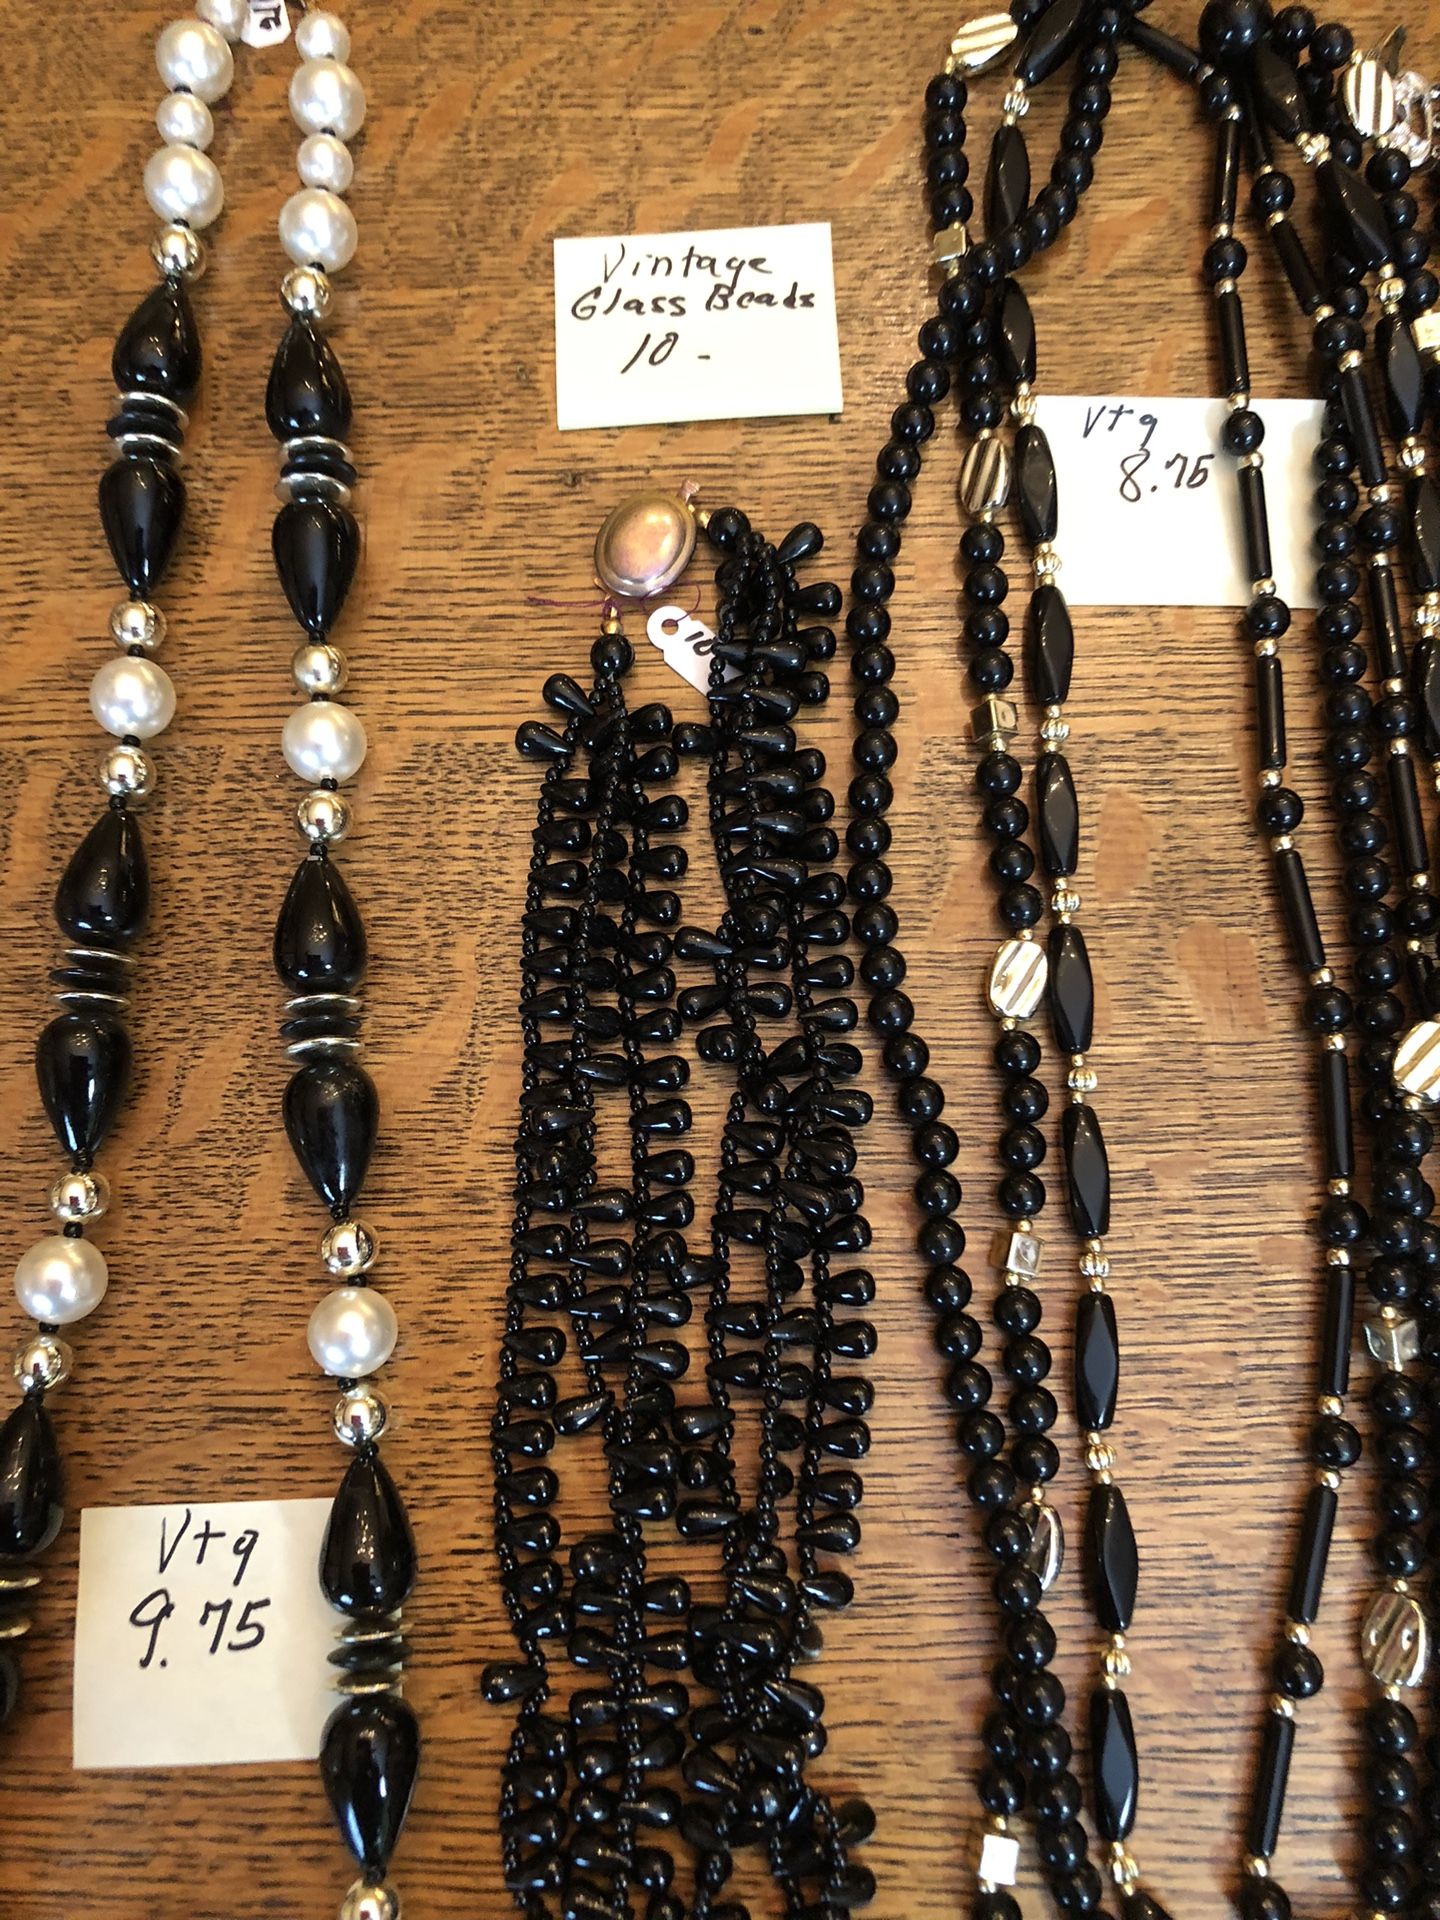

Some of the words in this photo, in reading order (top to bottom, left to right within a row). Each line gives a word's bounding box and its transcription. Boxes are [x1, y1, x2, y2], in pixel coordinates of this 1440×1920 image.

[603, 243, 773, 296] Vintage
[571, 285, 686, 320] Glass
[705, 281, 816, 312] Beads
[1083, 404, 1158, 451] Vtg
[1119, 448, 1215, 502] 8.75
[159, 1508, 259, 1586] Vtg
[129, 1588, 271, 1668] 9.75
